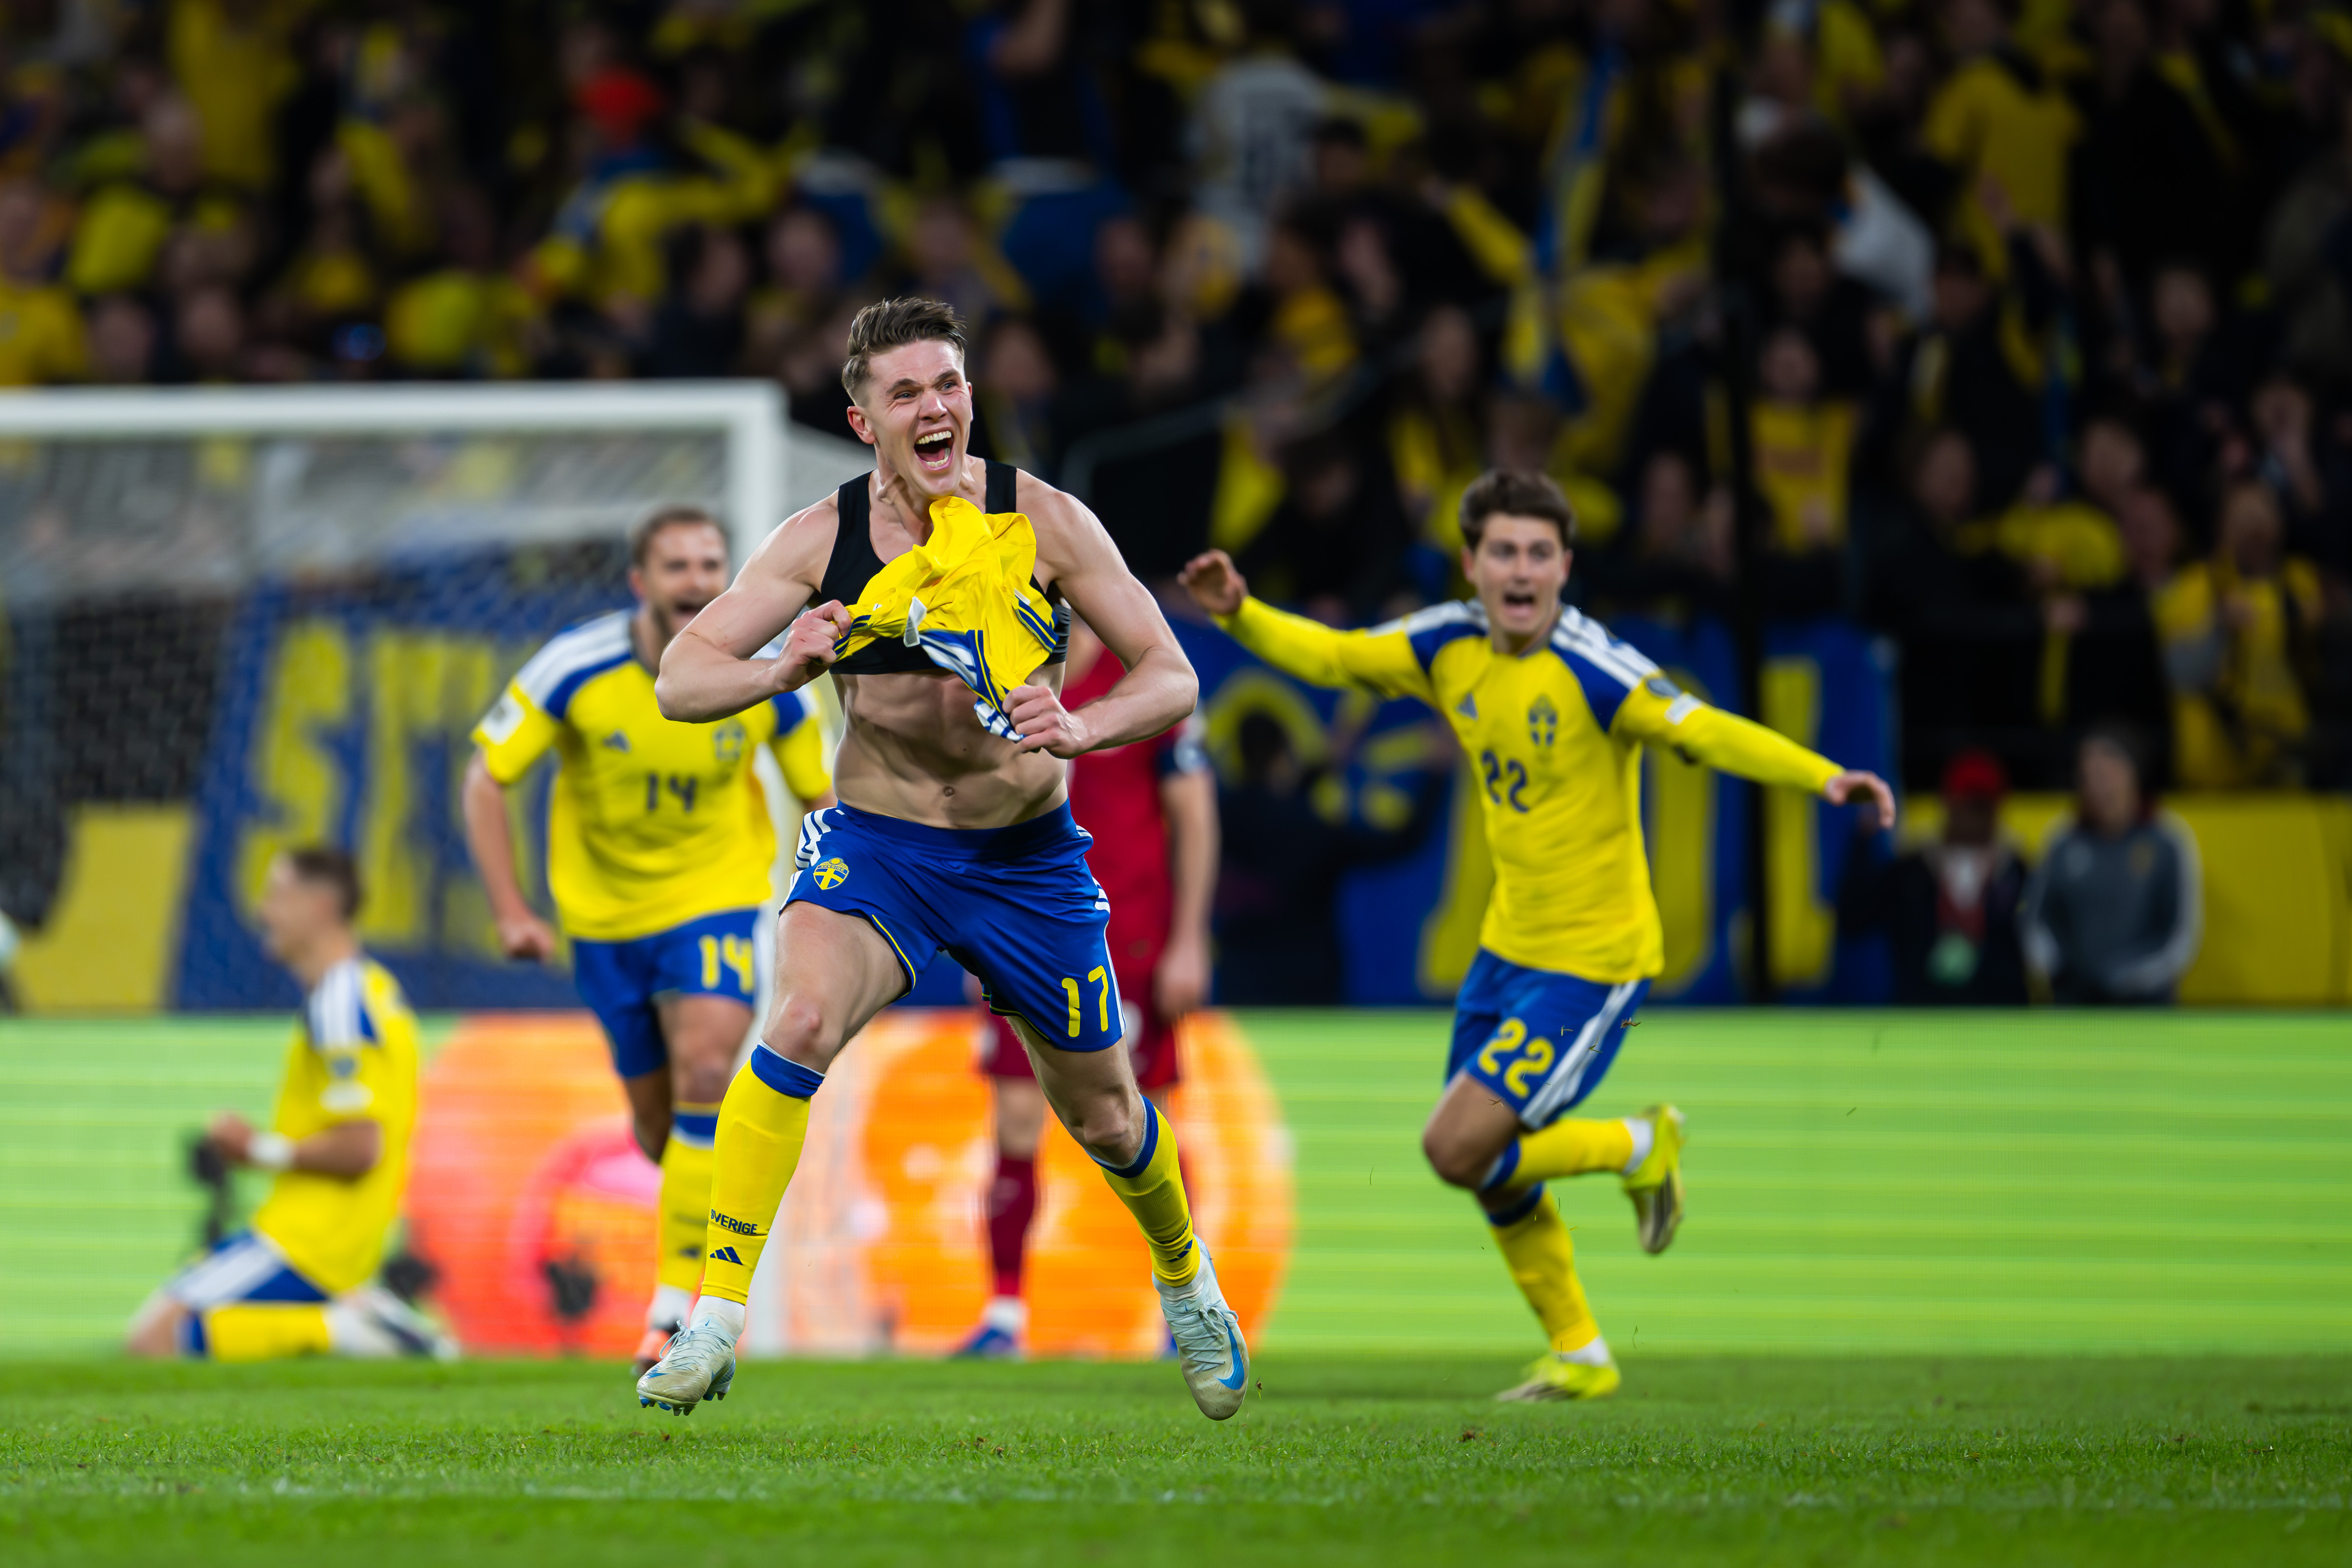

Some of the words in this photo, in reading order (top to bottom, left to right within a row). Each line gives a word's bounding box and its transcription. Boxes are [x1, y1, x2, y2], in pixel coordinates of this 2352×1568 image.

[646, 771, 698, 813] 14
[1481, 749, 1530, 814] 22
[699, 933, 754, 994] 14
[1061, 965, 1109, 1038] 17
[1477, 1016, 1556, 1099] 22
[710, 1209, 758, 1235] SVERIGE
